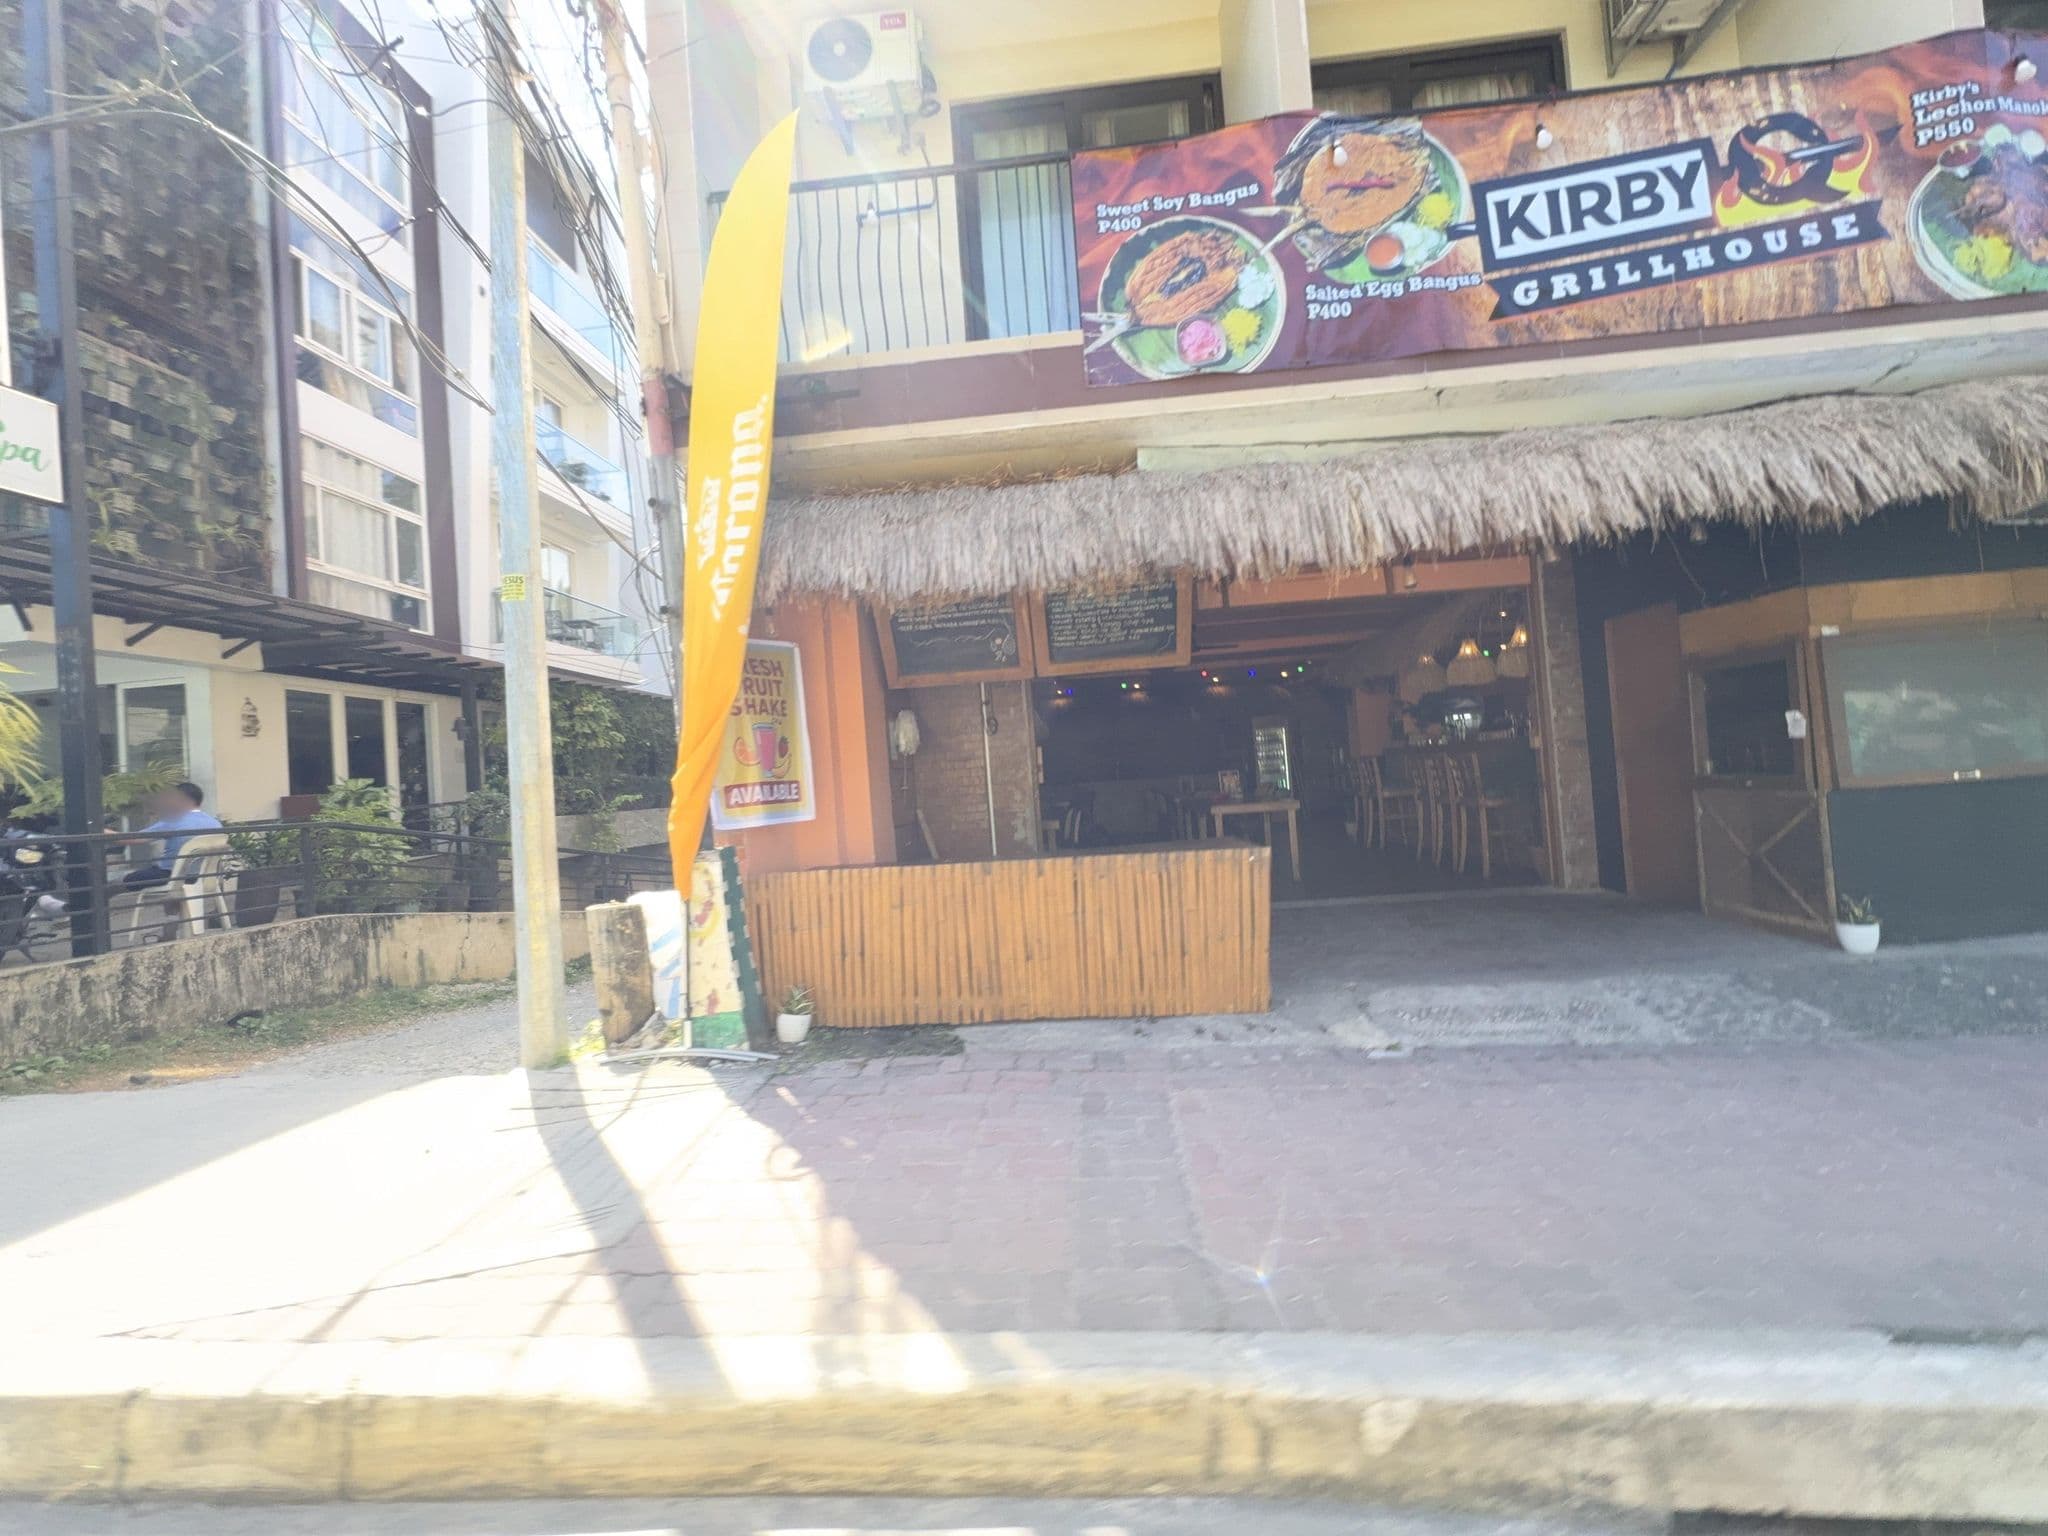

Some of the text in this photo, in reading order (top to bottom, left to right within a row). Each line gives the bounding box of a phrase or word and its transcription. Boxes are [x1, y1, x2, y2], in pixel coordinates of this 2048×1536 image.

[1911, 80, 1980, 109] Kirby's
[1914, 98, 1996, 126] Lechon
[1916, 117, 1975, 146] P550
[1096, 182, 1260, 218] Sweet Soy Bangus
[1493, 159, 1704, 249] KIRBY
[1097, 216, 1143, 234] P400
[1512, 213, 1860, 307] GRILLHOUSE
[1305, 273, 1482, 302] Salted Egg Bangus
[1306, 301, 1353, 321] P400
[0, 436, 50, 472] pa
[743, 658, 785, 679] ESH
[743, 677, 784, 698] RUIT
[729, 698, 788, 718] SHAKE
